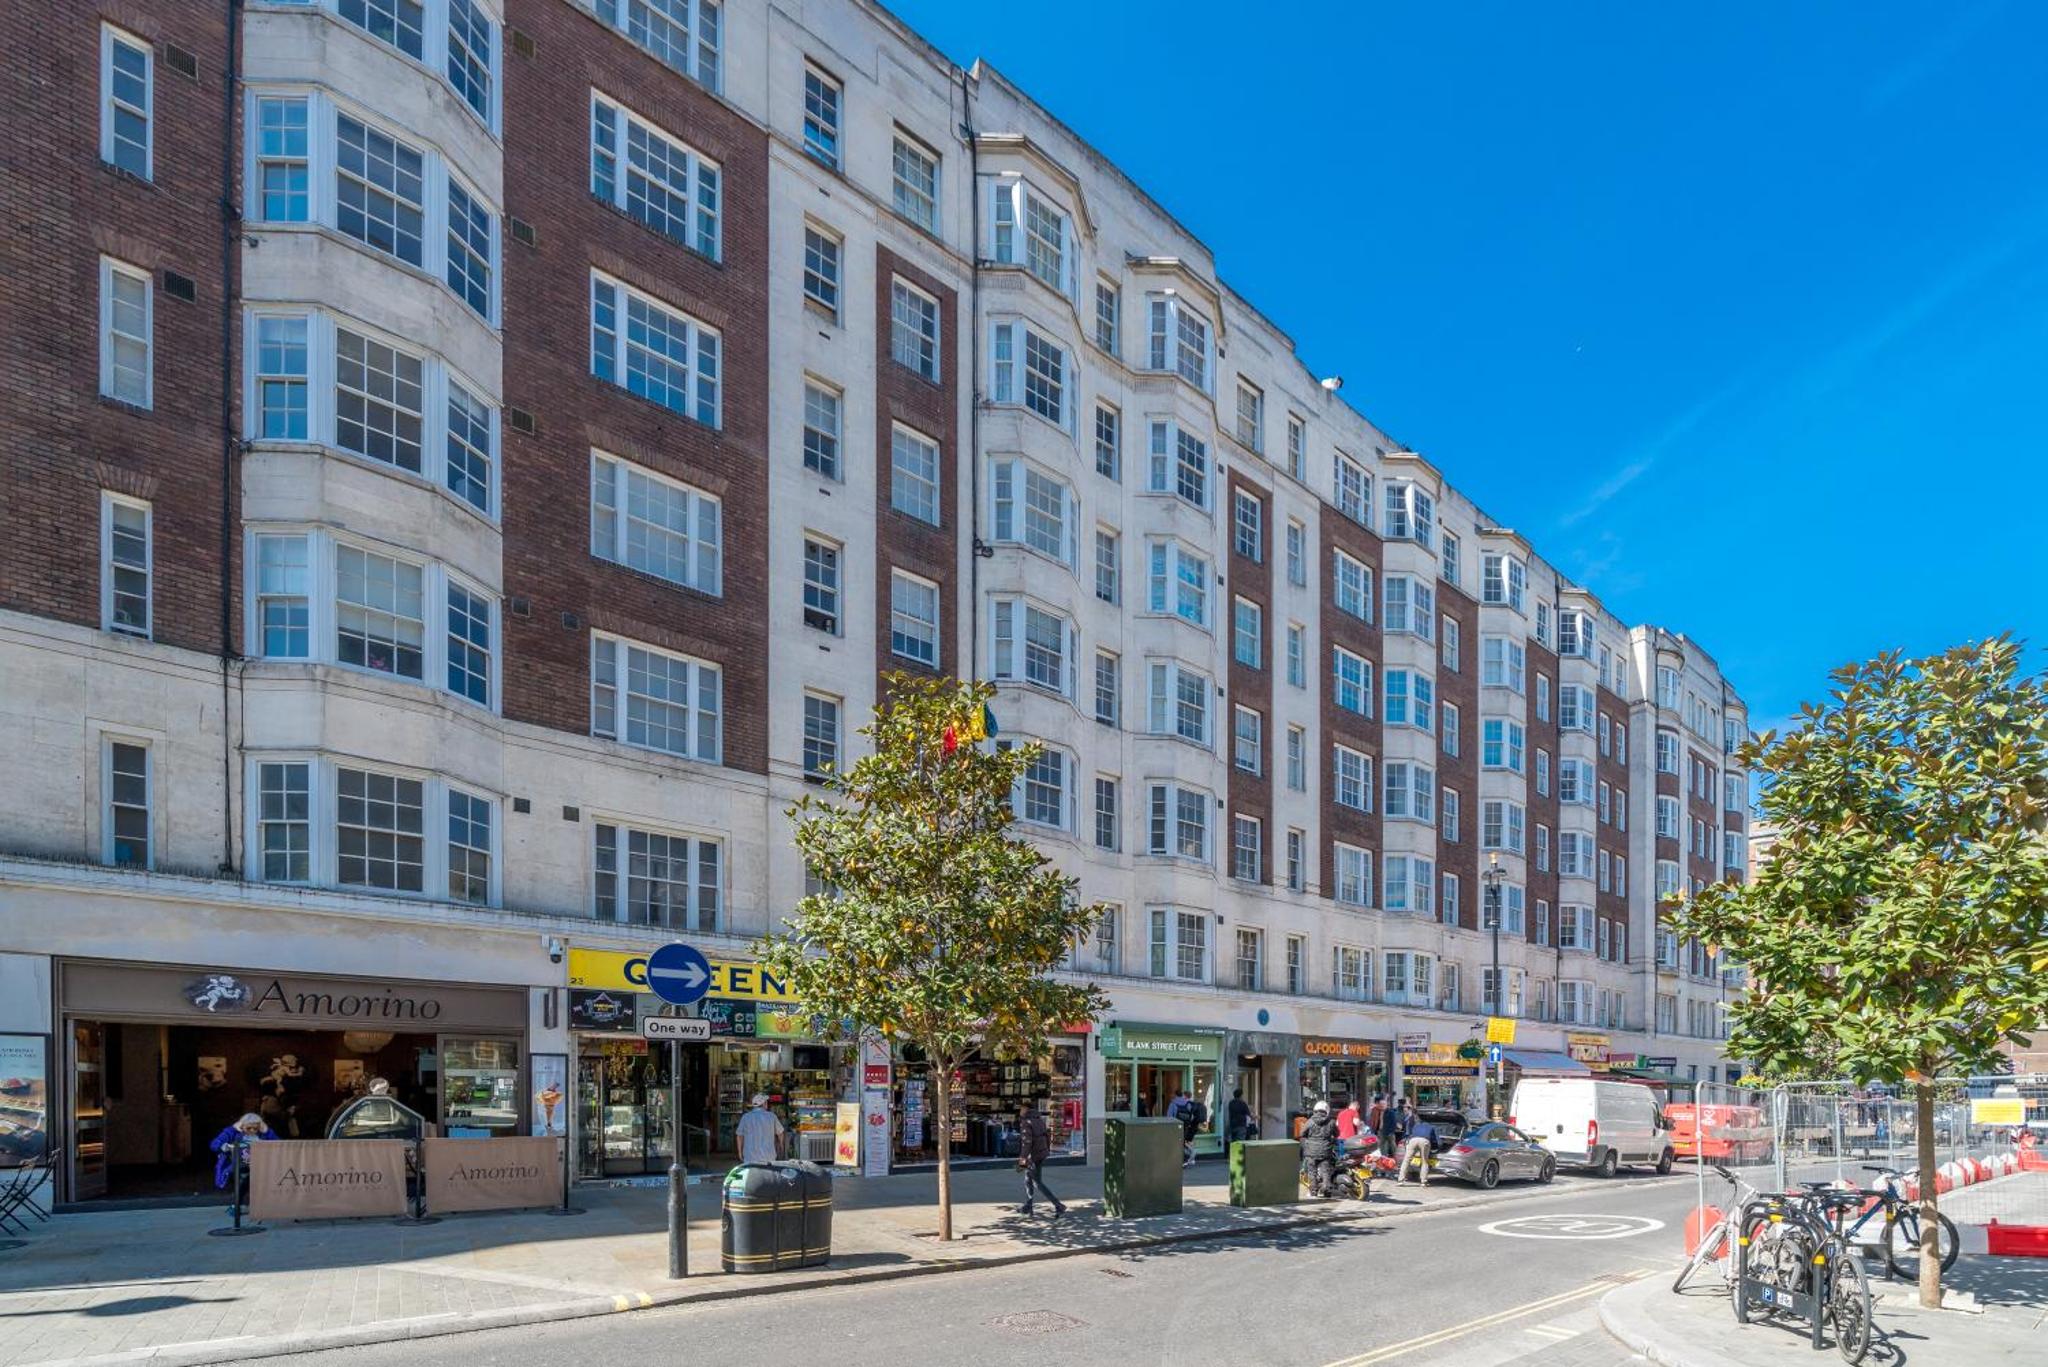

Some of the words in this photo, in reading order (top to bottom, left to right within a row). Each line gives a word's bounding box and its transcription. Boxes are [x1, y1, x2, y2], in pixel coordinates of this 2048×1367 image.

[252, 979, 441, 1019] Amorino
[649, 1022, 676, 1033] One
[680, 1025, 706, 1036] way
[1127, 1041, 1150, 1050] BLANK
[1151, 1042, 1178, 1051] STREET
[1179, 1043, 1203, 1053] COFFEE
[277, 1166, 383, 1186] Amorino
[448, 1161, 539, 1181] Amorino
